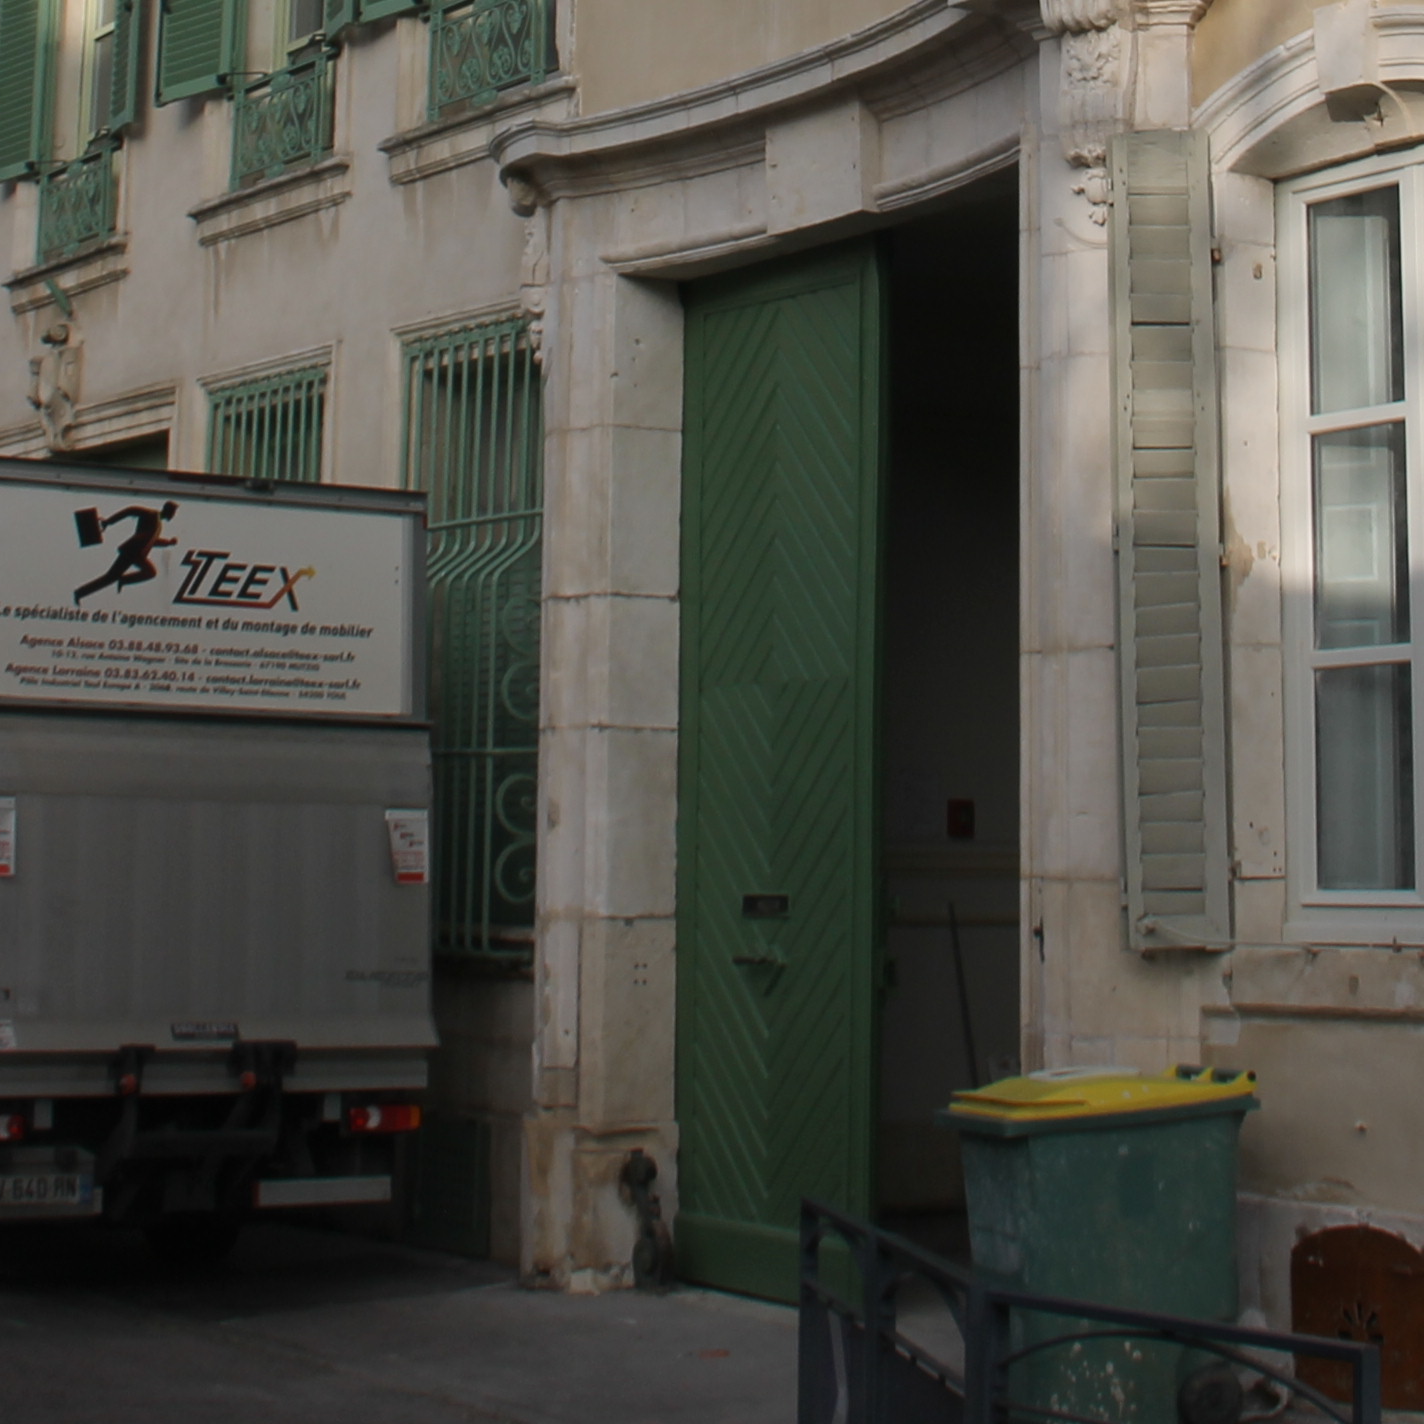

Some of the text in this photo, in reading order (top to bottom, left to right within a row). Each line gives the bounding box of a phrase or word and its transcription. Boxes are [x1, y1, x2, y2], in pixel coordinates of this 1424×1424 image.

[14, 604, 88, 621] spécialiste
[91, 610, 108, 623] de
[112, 610, 202, 628] l'agencement
[206, 617, 219, 629] et
[222, 618, 238, 631] du
[241, 621, 298, 636] montage
[300, 623, 316, 635] de
[319, 624, 373, 638] mobilier
[20, 634, 64, 649] Agence
[67, 636, 105, 650] Alsace
[5, 662, 49, 677] Agence
[53, 664, 101, 679] Lorraine
